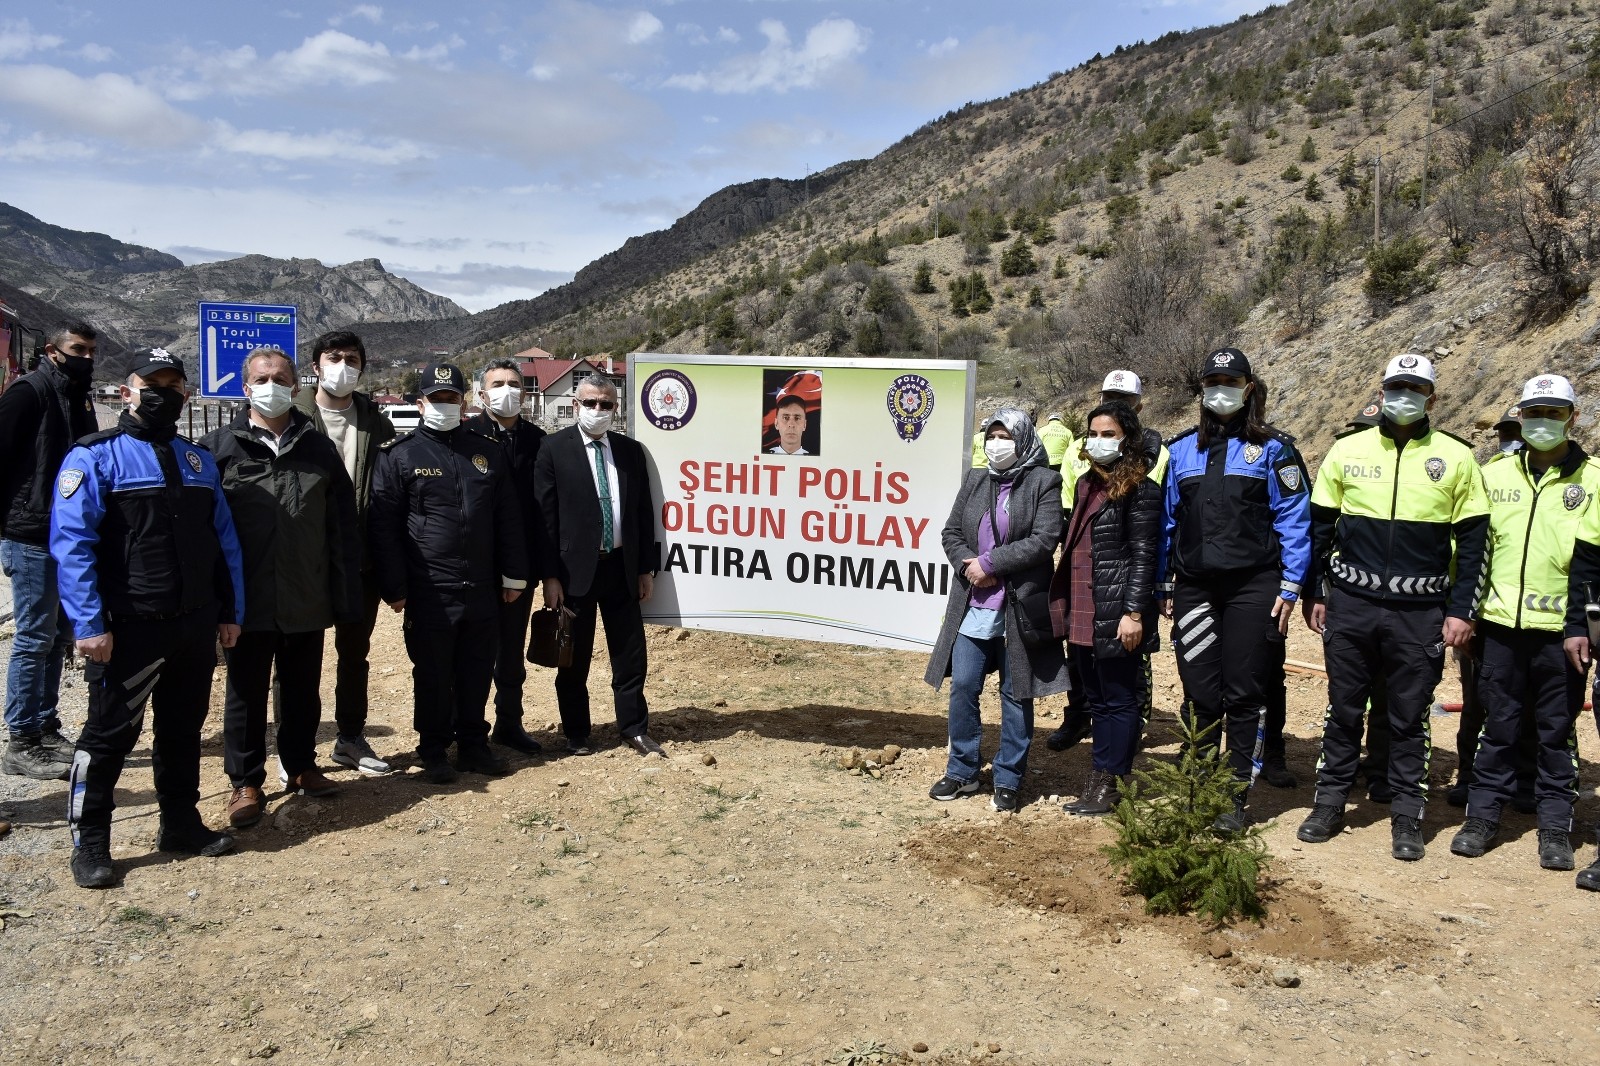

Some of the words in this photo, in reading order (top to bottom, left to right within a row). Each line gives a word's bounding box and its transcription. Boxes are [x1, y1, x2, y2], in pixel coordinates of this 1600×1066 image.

[210, 311, 249, 321] D.885
[221, 326, 260, 338] Torul
[679, 455, 786, 501] ŞEHİT
[799, 461, 910, 505] POLİS
[661, 501, 786, 540] OLGUN
[801, 503, 930, 549] GÜLAY
[786, 551, 949, 596] ORMANI
